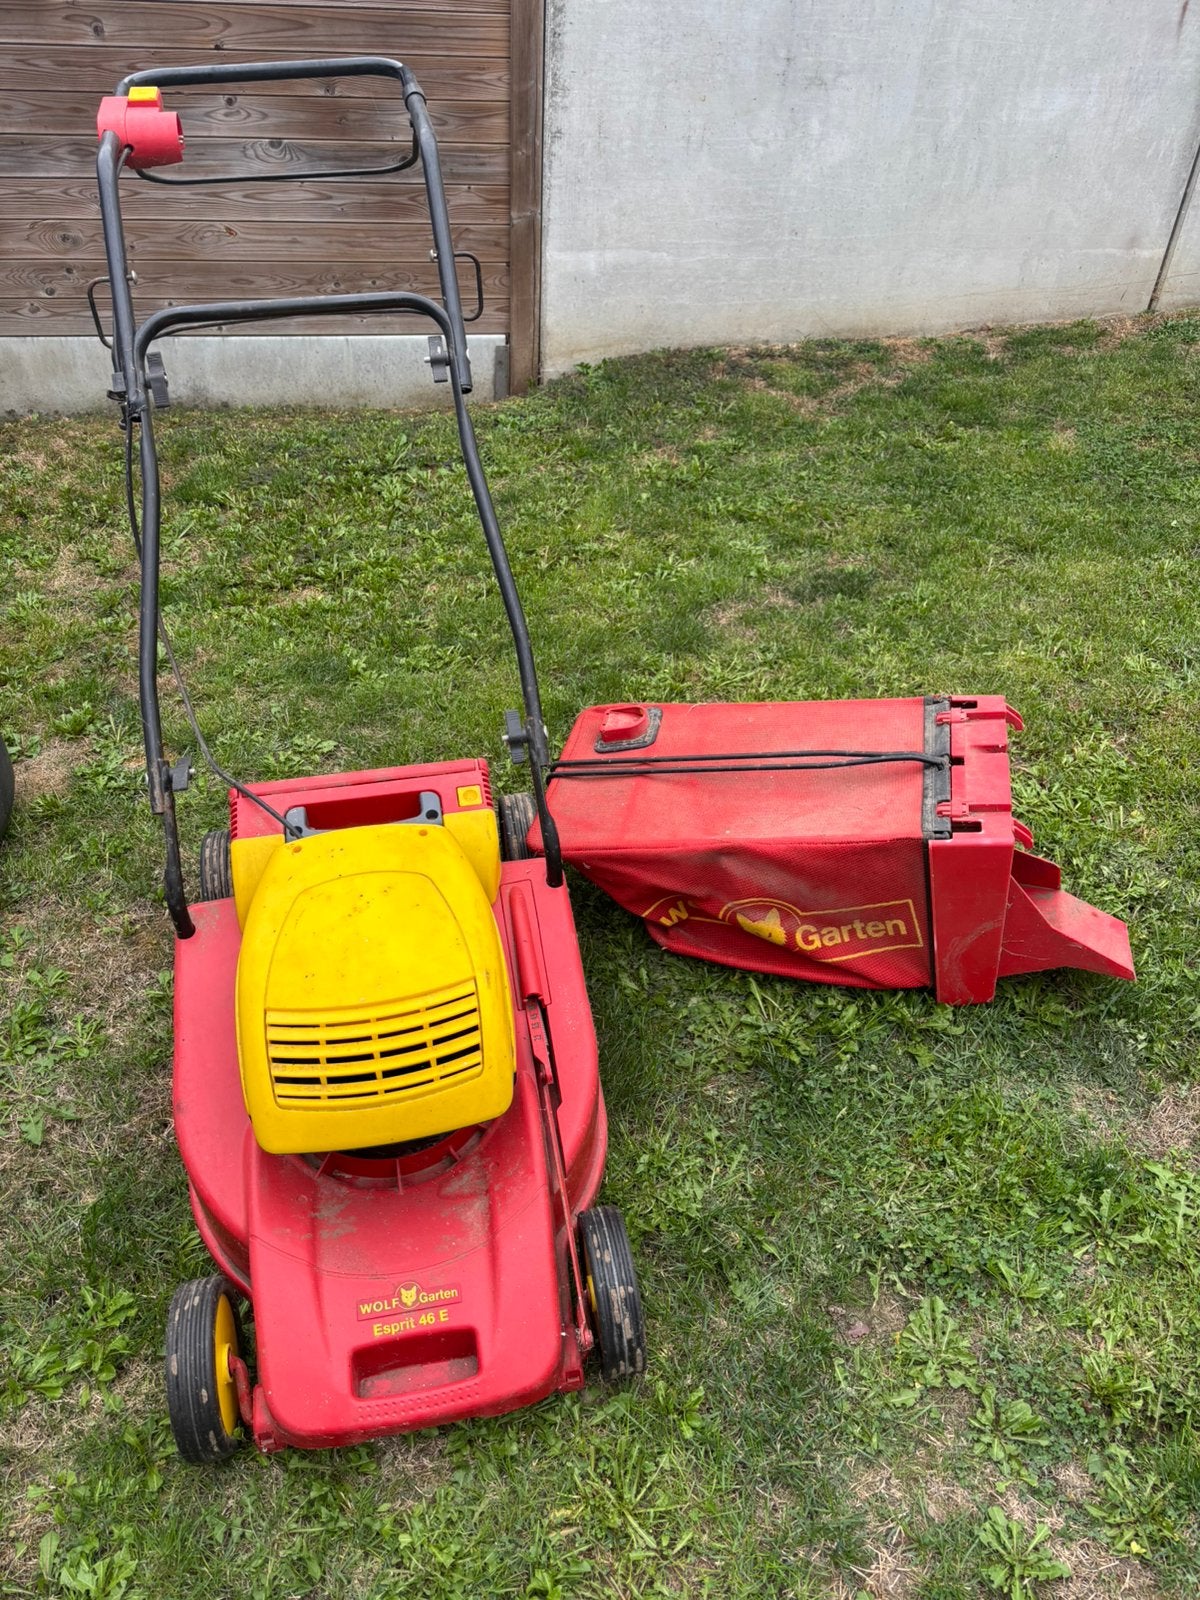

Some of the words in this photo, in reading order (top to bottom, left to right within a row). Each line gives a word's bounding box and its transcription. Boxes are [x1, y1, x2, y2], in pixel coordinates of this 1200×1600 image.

[660, 900, 698, 927] W
[795, 919, 907, 951] Garten
[360, 1298, 400, 1314] WOLF
[419, 1289, 458, 1303] Garten
[373, 1318, 415, 1336] Esprit
[418, 1313, 435, 1326] 46
[439, 1308, 449, 1322] E
